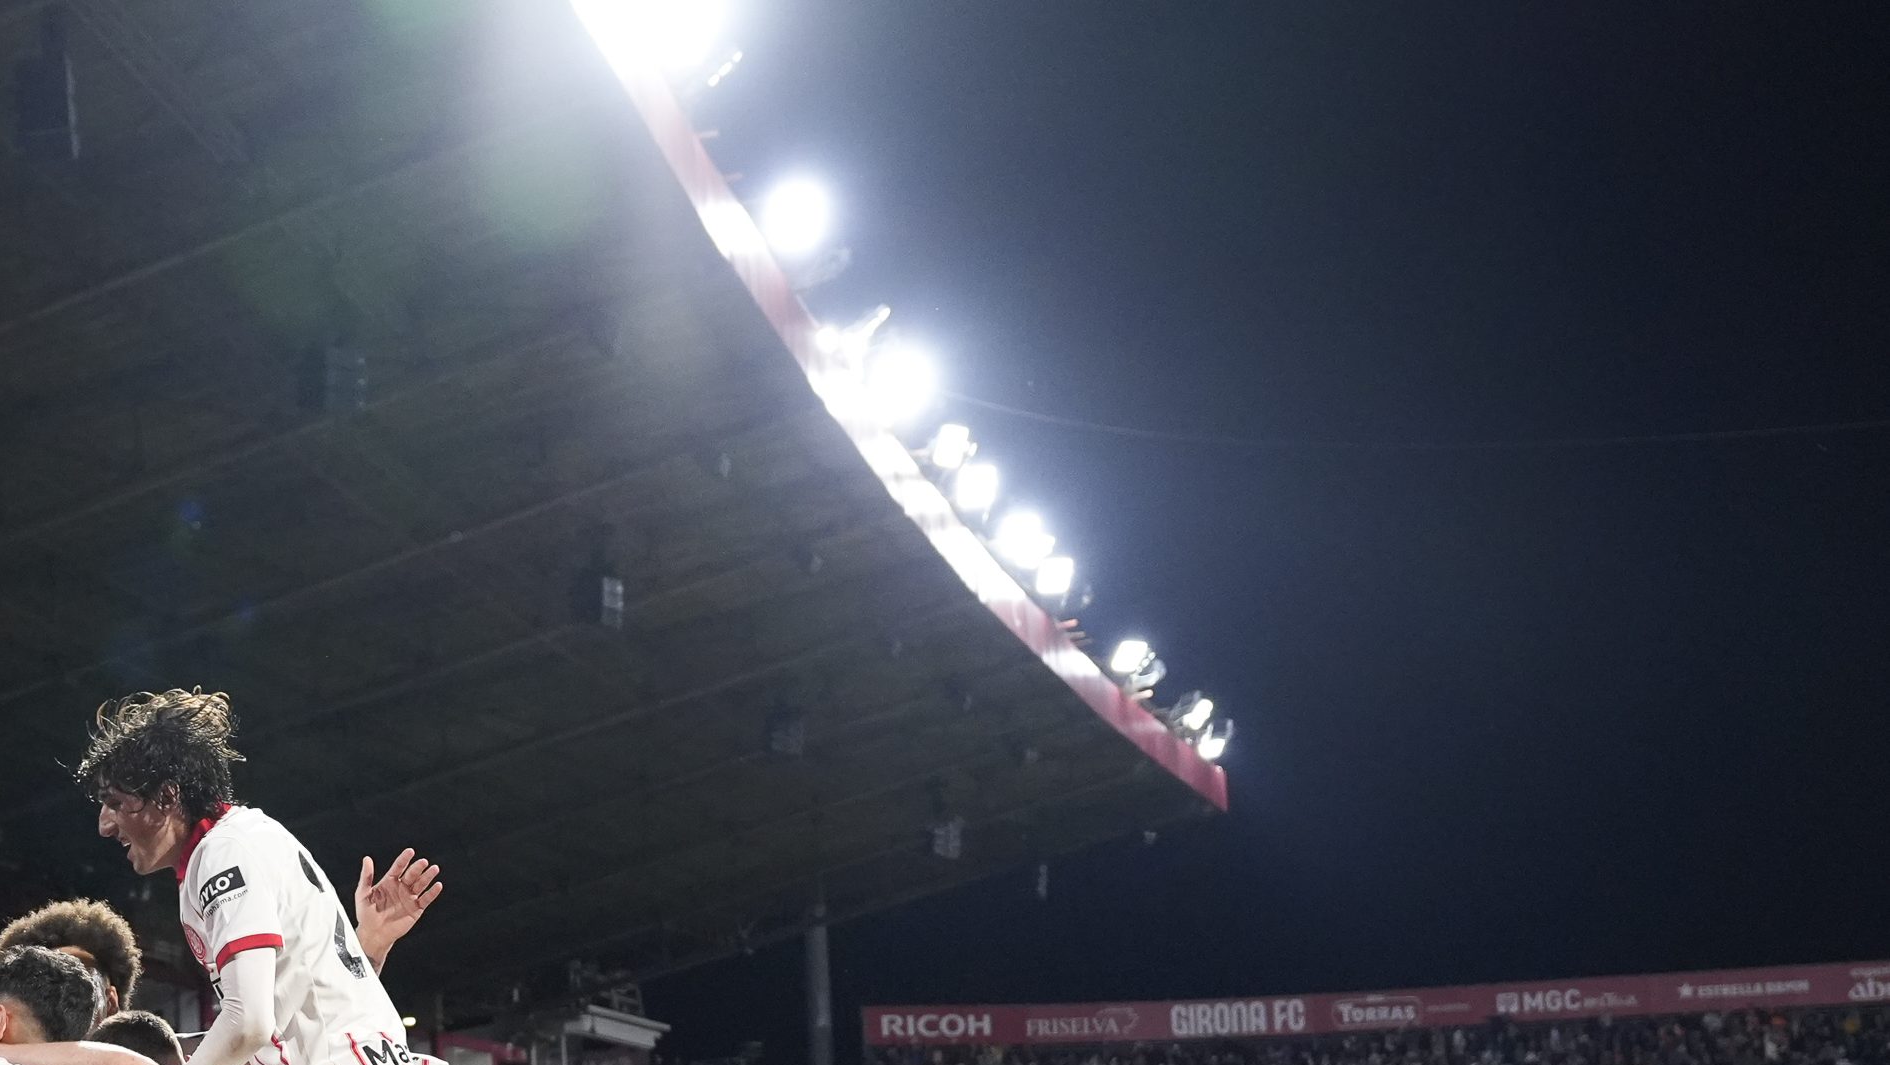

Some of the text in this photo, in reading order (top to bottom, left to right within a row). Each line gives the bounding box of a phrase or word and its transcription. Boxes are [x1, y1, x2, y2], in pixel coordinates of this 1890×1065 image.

[1522, 988, 1583, 1012] MGC
[880, 1013, 992, 1037] RICOH
[1025, 1016, 1121, 1037] FRISELVA
[1170, 999, 1306, 1036] GIRONA FC
